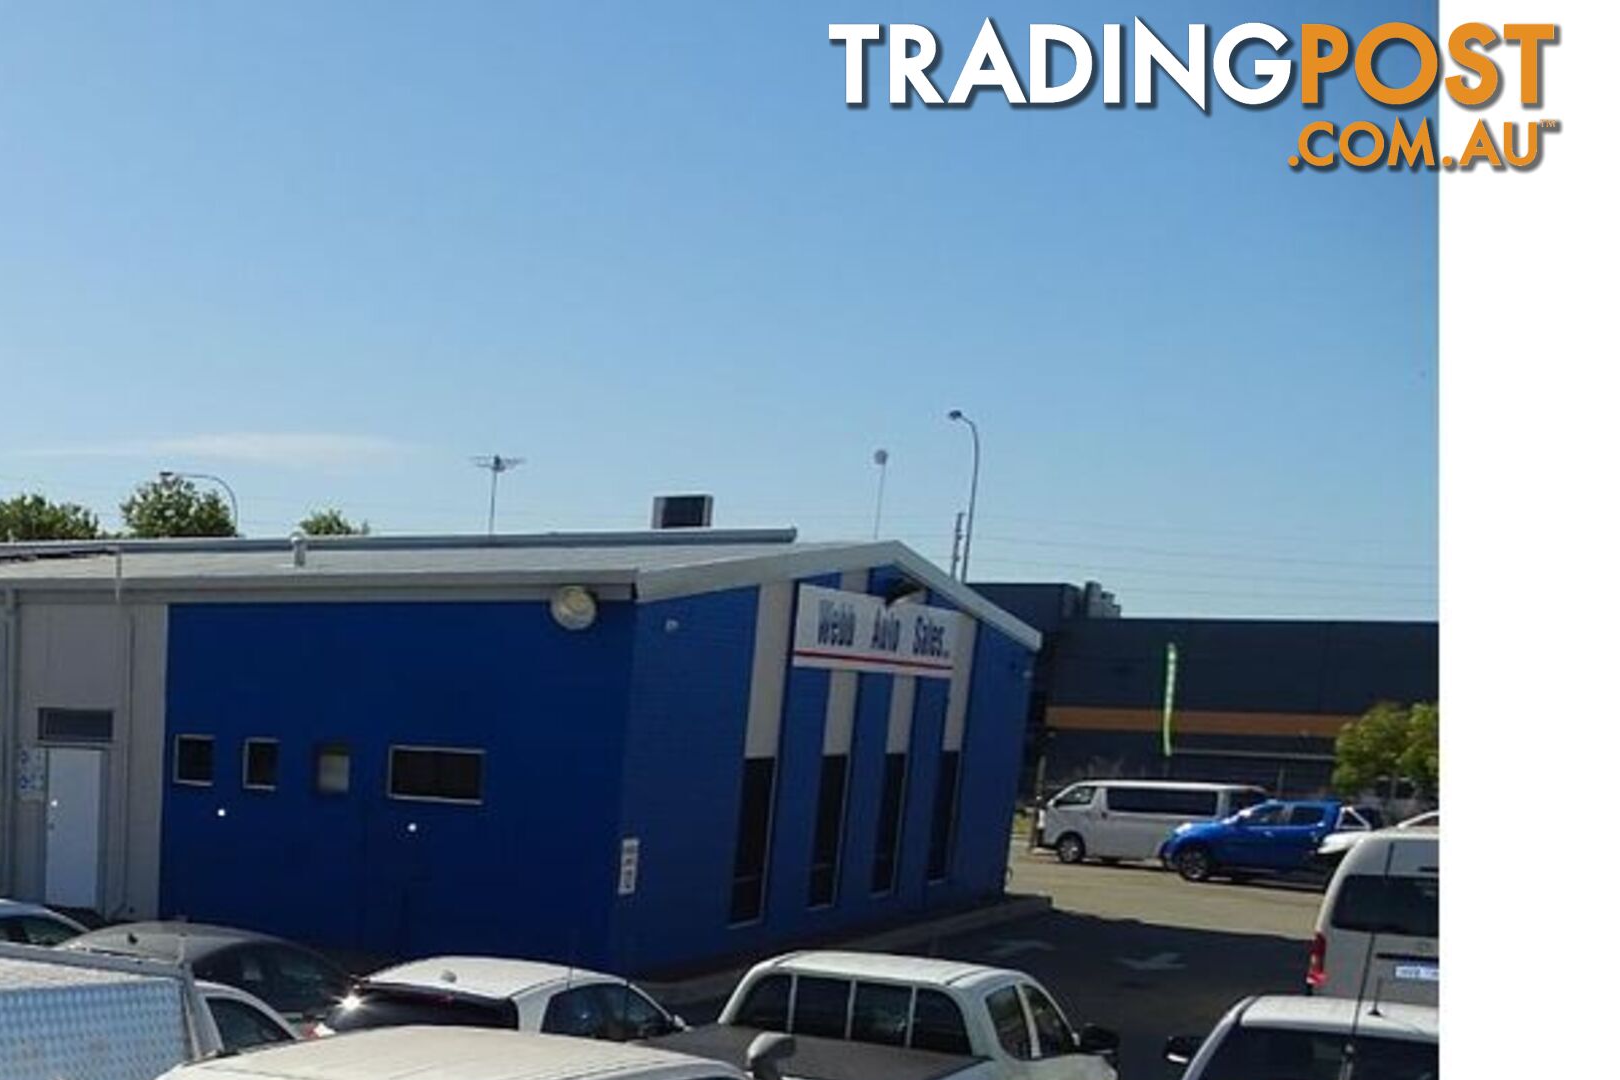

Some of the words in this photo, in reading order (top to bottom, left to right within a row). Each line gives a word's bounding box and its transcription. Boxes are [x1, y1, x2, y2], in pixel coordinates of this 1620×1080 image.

[817, 600, 856, 647] Webb
[870, 606, 901, 653] Auto
[911, 613, 945, 657] Sales
